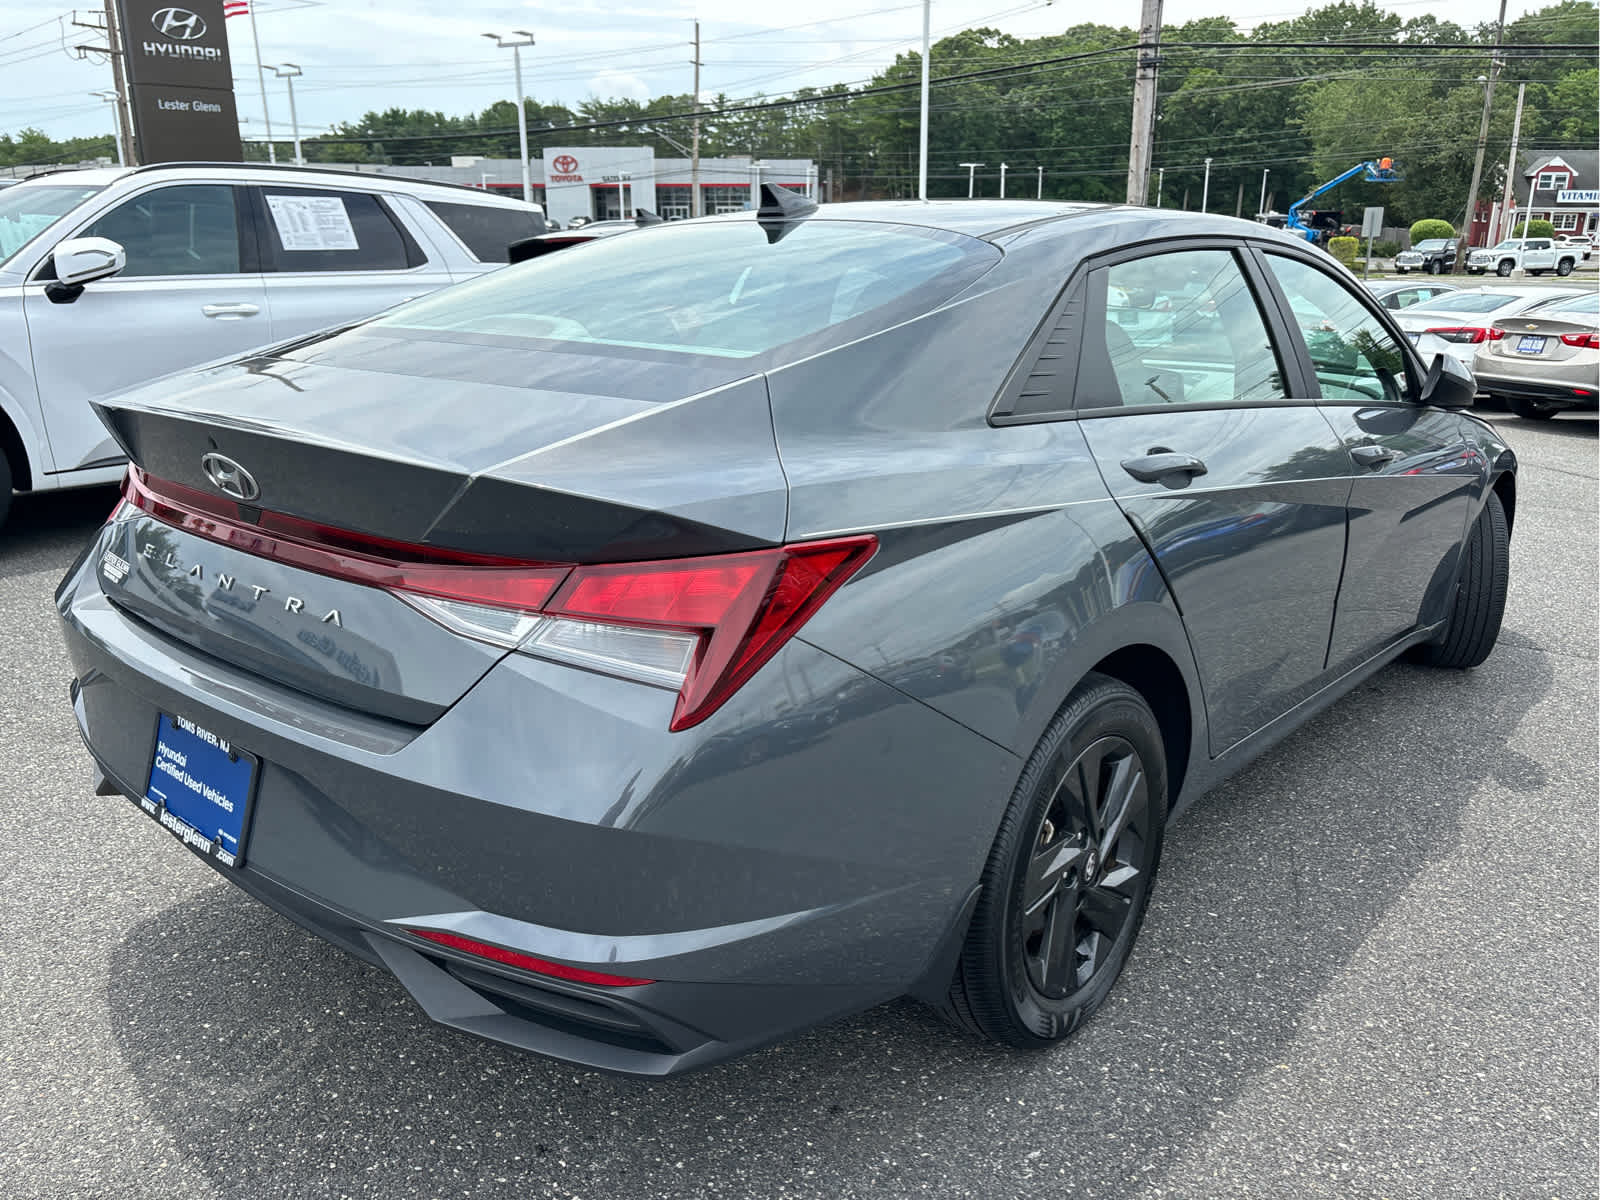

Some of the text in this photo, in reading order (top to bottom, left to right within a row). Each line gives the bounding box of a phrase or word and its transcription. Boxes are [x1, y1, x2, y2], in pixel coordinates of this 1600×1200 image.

[143, 41, 221, 60] HYUNDAI
[158, 99, 221, 112] Lester Glenn
[550, 175, 583, 183] TOYOTA
[1561, 191, 1599, 200] VITAMI
[143, 543, 343, 628] ELANTRA
[177, 715, 230, 753] TOMS RIVER, NJ
[158, 741, 188, 767] Hyundai
[155, 756, 184, 782] Certified
[184, 773, 203, 794] Used
[203, 784, 235, 813] Vehicles
